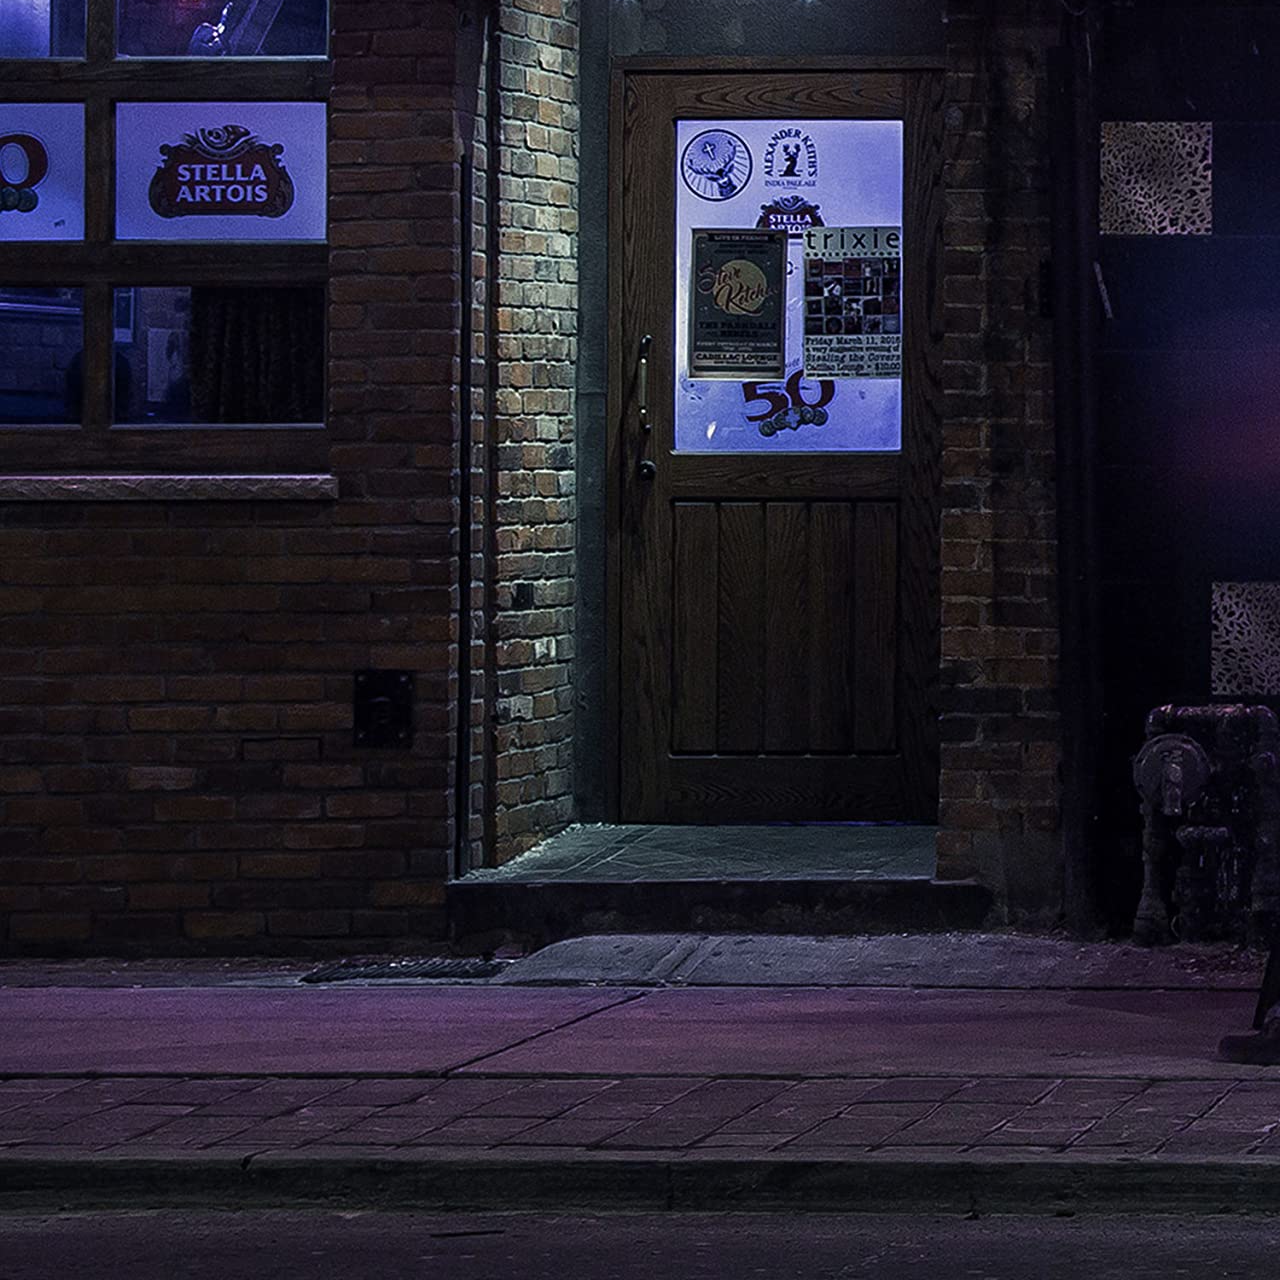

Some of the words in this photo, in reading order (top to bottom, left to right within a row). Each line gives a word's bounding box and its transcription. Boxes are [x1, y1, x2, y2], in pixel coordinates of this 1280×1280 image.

[177, 164, 267, 182] STELLA
[175, 184, 269, 203] ARTOIS
[769, 214, 812, 223] STELLA
[805, 228, 900, 250] trixie
[805, 336, 833, 347] Friday
[836, 336, 863, 345] March
[805, 353, 846, 363] Stealing
[848, 353, 864, 362] the
[743, 370, 835, 422] 50
